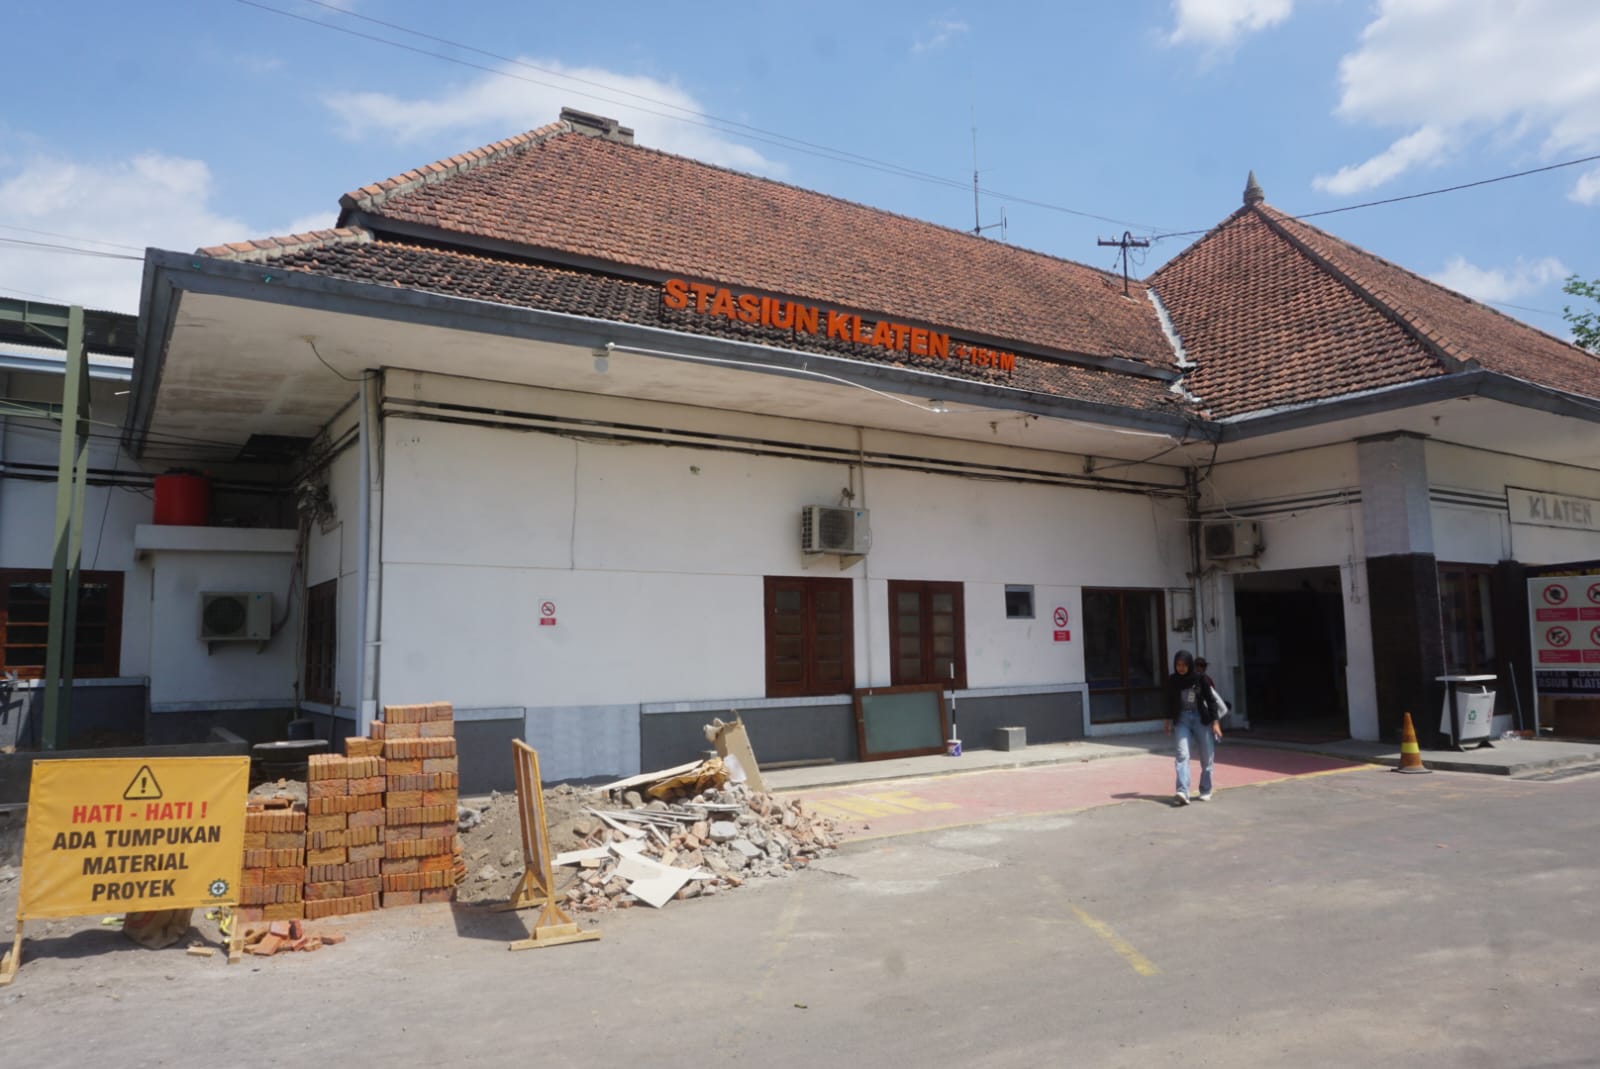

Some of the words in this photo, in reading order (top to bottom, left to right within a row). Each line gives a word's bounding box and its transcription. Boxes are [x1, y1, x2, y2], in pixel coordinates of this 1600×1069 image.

[663, 278, 819, 334] STASIUN
[826, 309, 950, 360] KLATEN
[1528, 495, 1594, 526] KLATEN
[72, 804, 122, 824] HATI
[145, 802, 193, 821] HATI
[52, 831, 96, 850] ADA
[105, 825, 221, 848] TUMPUKAN
[82, 852, 189, 875] MATERIAL
[91, 879, 176, 901] PROYEK
